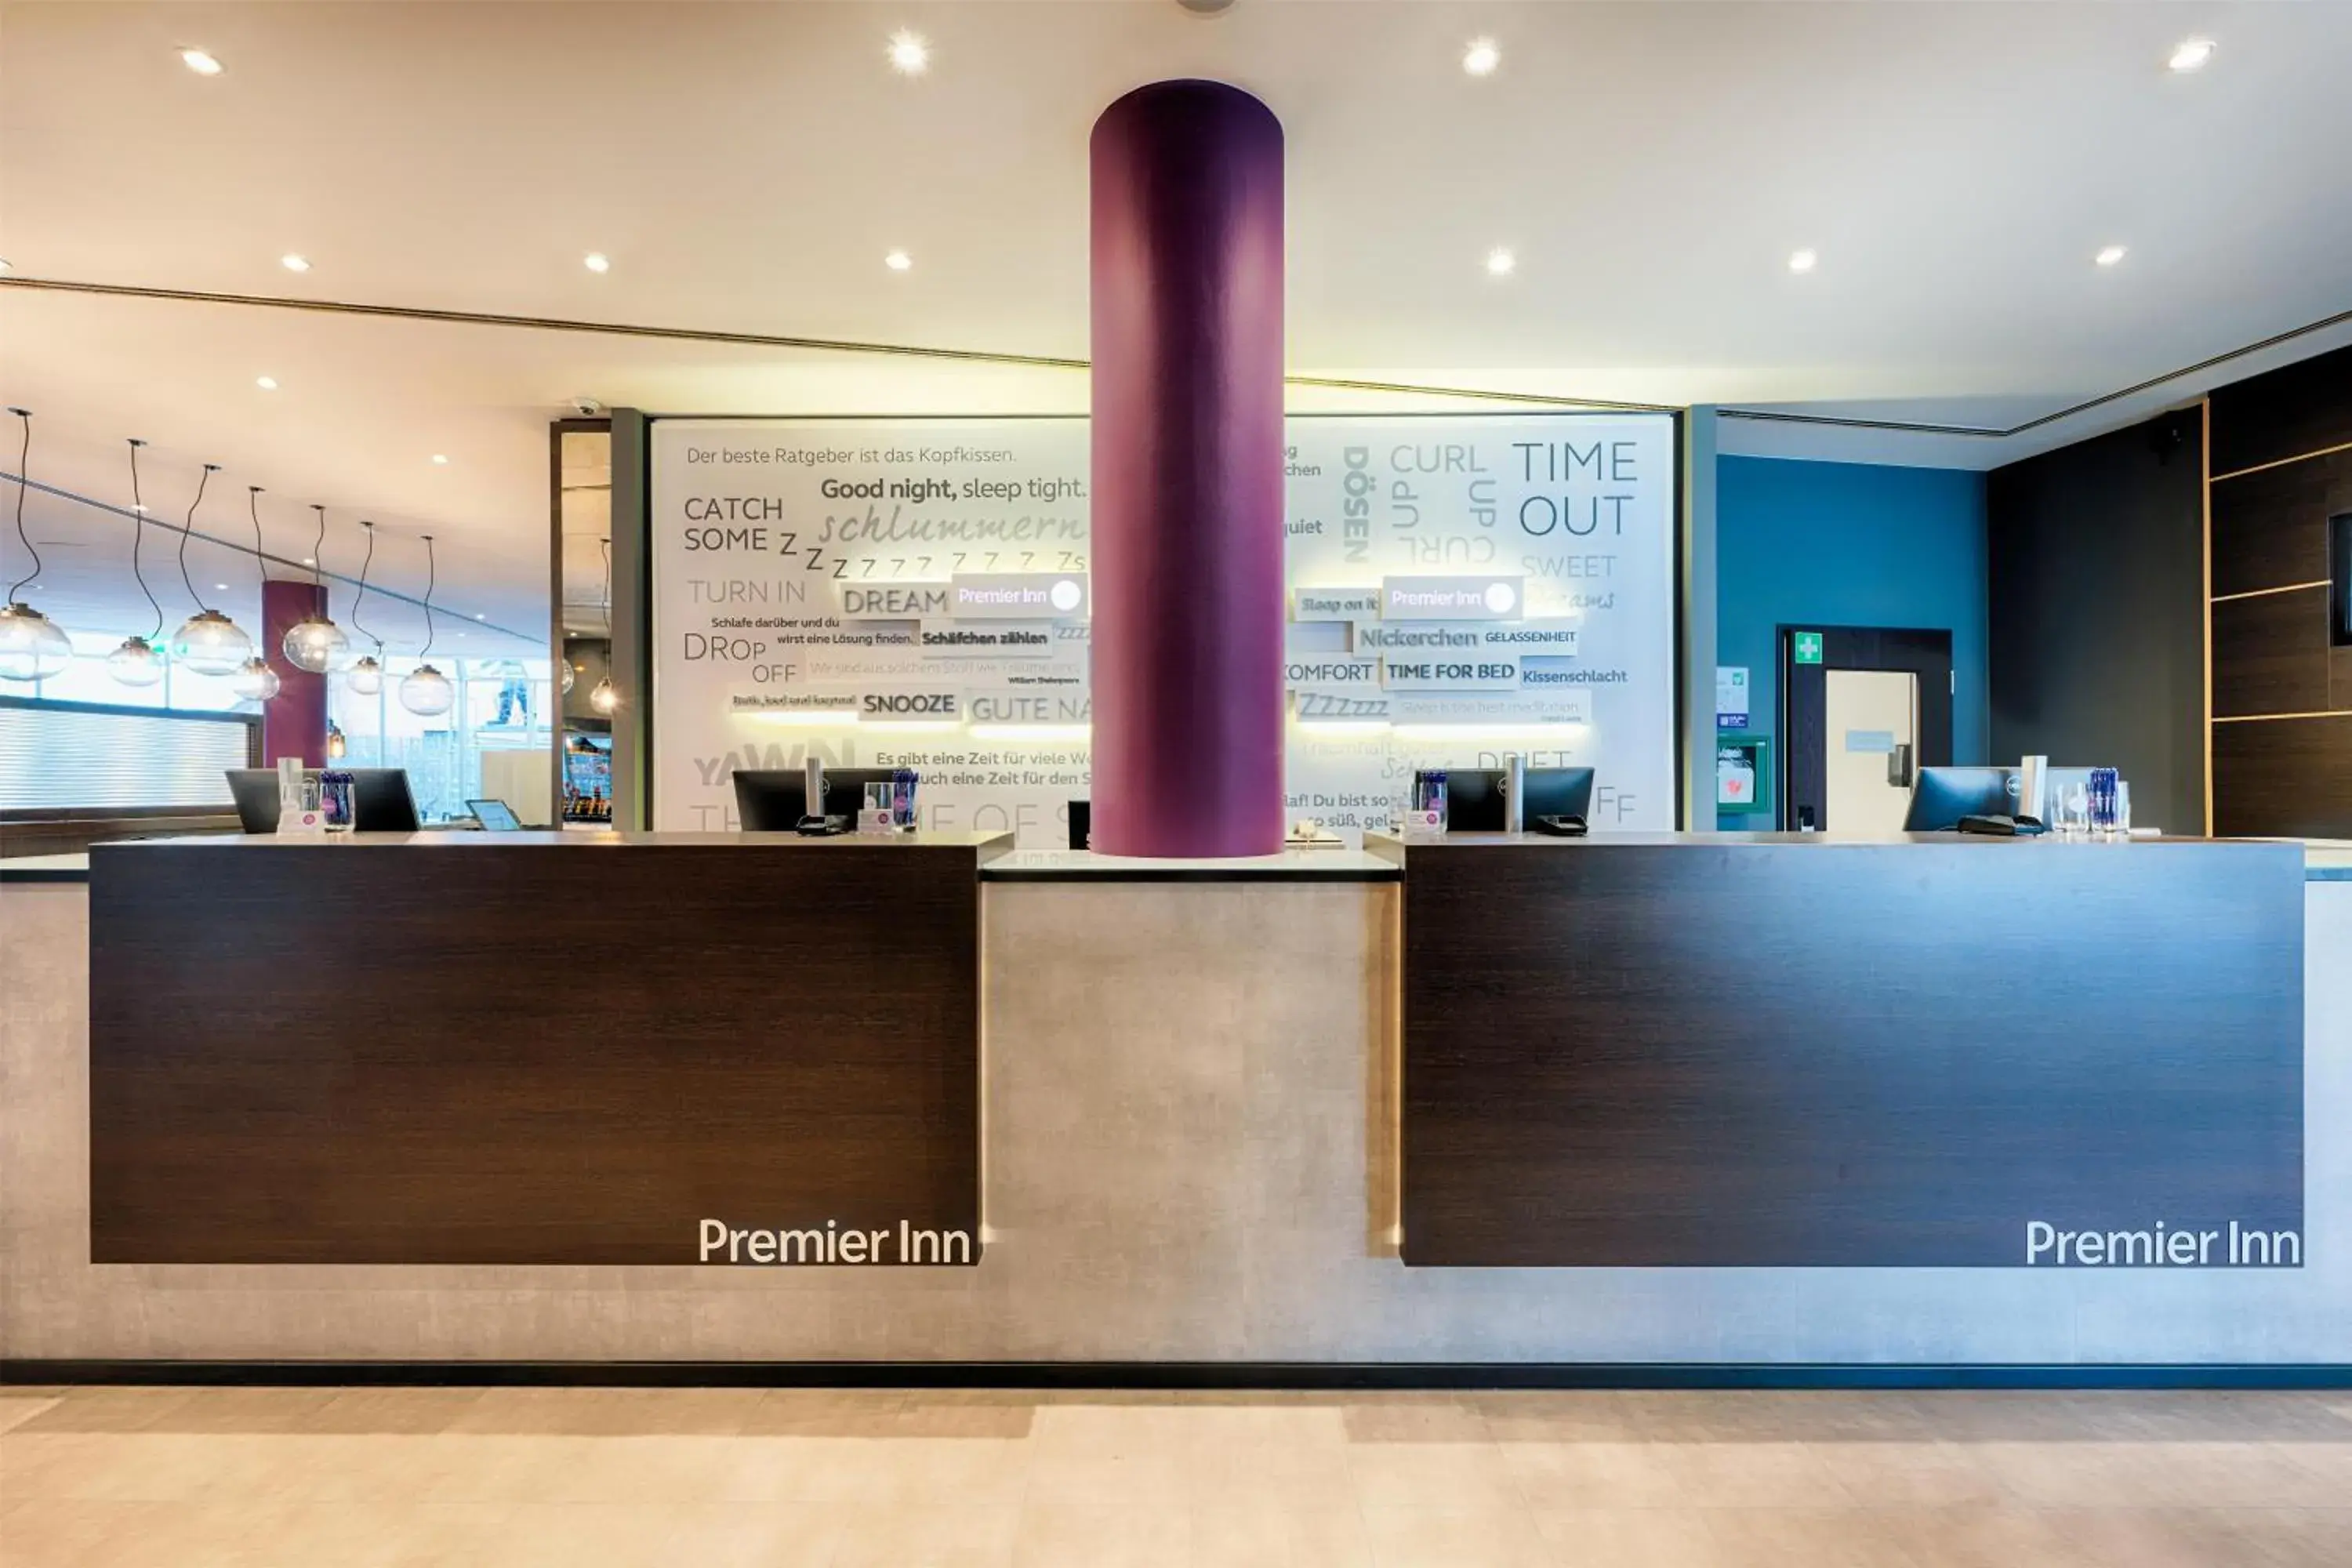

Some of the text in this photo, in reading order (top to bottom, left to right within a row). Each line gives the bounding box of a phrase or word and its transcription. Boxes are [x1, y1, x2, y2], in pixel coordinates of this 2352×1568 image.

[687, 446, 1016, 466] Der beste Ratgeber ist das Kopfkissen.
[1390, 445, 1487, 473] CURL
[1512, 441, 1637, 481] TIME
[821, 477, 1087, 503] Good night, sleep tight.
[684, 497, 782, 520] CATCH
[1343, 446, 1377, 563] DÖSEN
[1392, 480, 1418, 528] UP
[1468, 480, 1496, 527] UP
[818, 504, 1088, 543] schlummern
[1519, 495, 1635, 535] OUT
[684, 528, 768, 550] SOME
[1522, 555, 1617, 578] SWEET
[687, 579, 806, 604] TURN IN
[844, 590, 948, 614] DREAM
[959, 588, 1047, 603] Premier Inn
[1392, 590, 1482, 607] Premier Inn
[711, 617, 840, 628] Schlafe darüber und du
[684, 632, 766, 661] DROP
[777, 633, 804, 644] wirst
[807, 633, 829, 644] eine
[832, 633, 873, 646] Lösung
[922, 631, 1048, 644] Schäfchen zählen
[1360, 628, 1479, 648] Nickerchen
[1486, 631, 1577, 642] GELASSENHEIT
[752, 665, 797, 683] OFF
[1387, 664, 1515, 679] TIME FOR BED
[1523, 670, 1628, 683] Kissenschlacht
[863, 694, 955, 713] SNOOZE
[972, 698, 1049, 720] GUTE
[877, 752, 893, 765] Es
[898, 752, 928, 768] gibt
[932, 752, 964, 765] eine
[968, 752, 999, 765] Zeit
[1004, 752, 1025, 765] für
[1029, 752, 1065, 765] viele
[920, 771, 948, 785] uch
[953, 771, 985, 785] eine
[988, 771, 1020, 785] Zeit
[1022, 771, 1046, 785] für
[1049, 771, 1078, 785] den
[1313, 793, 1334, 807] Du
[1338, 793, 1368, 807] bist
[1371, 794, 1388, 807] so
[1597, 786, 1636, 823] FF
[1364, 814, 1388, 829] gel
[700, 1219, 970, 1263] Premier Inn
[2027, 1221, 2299, 1265] Premier Inn
